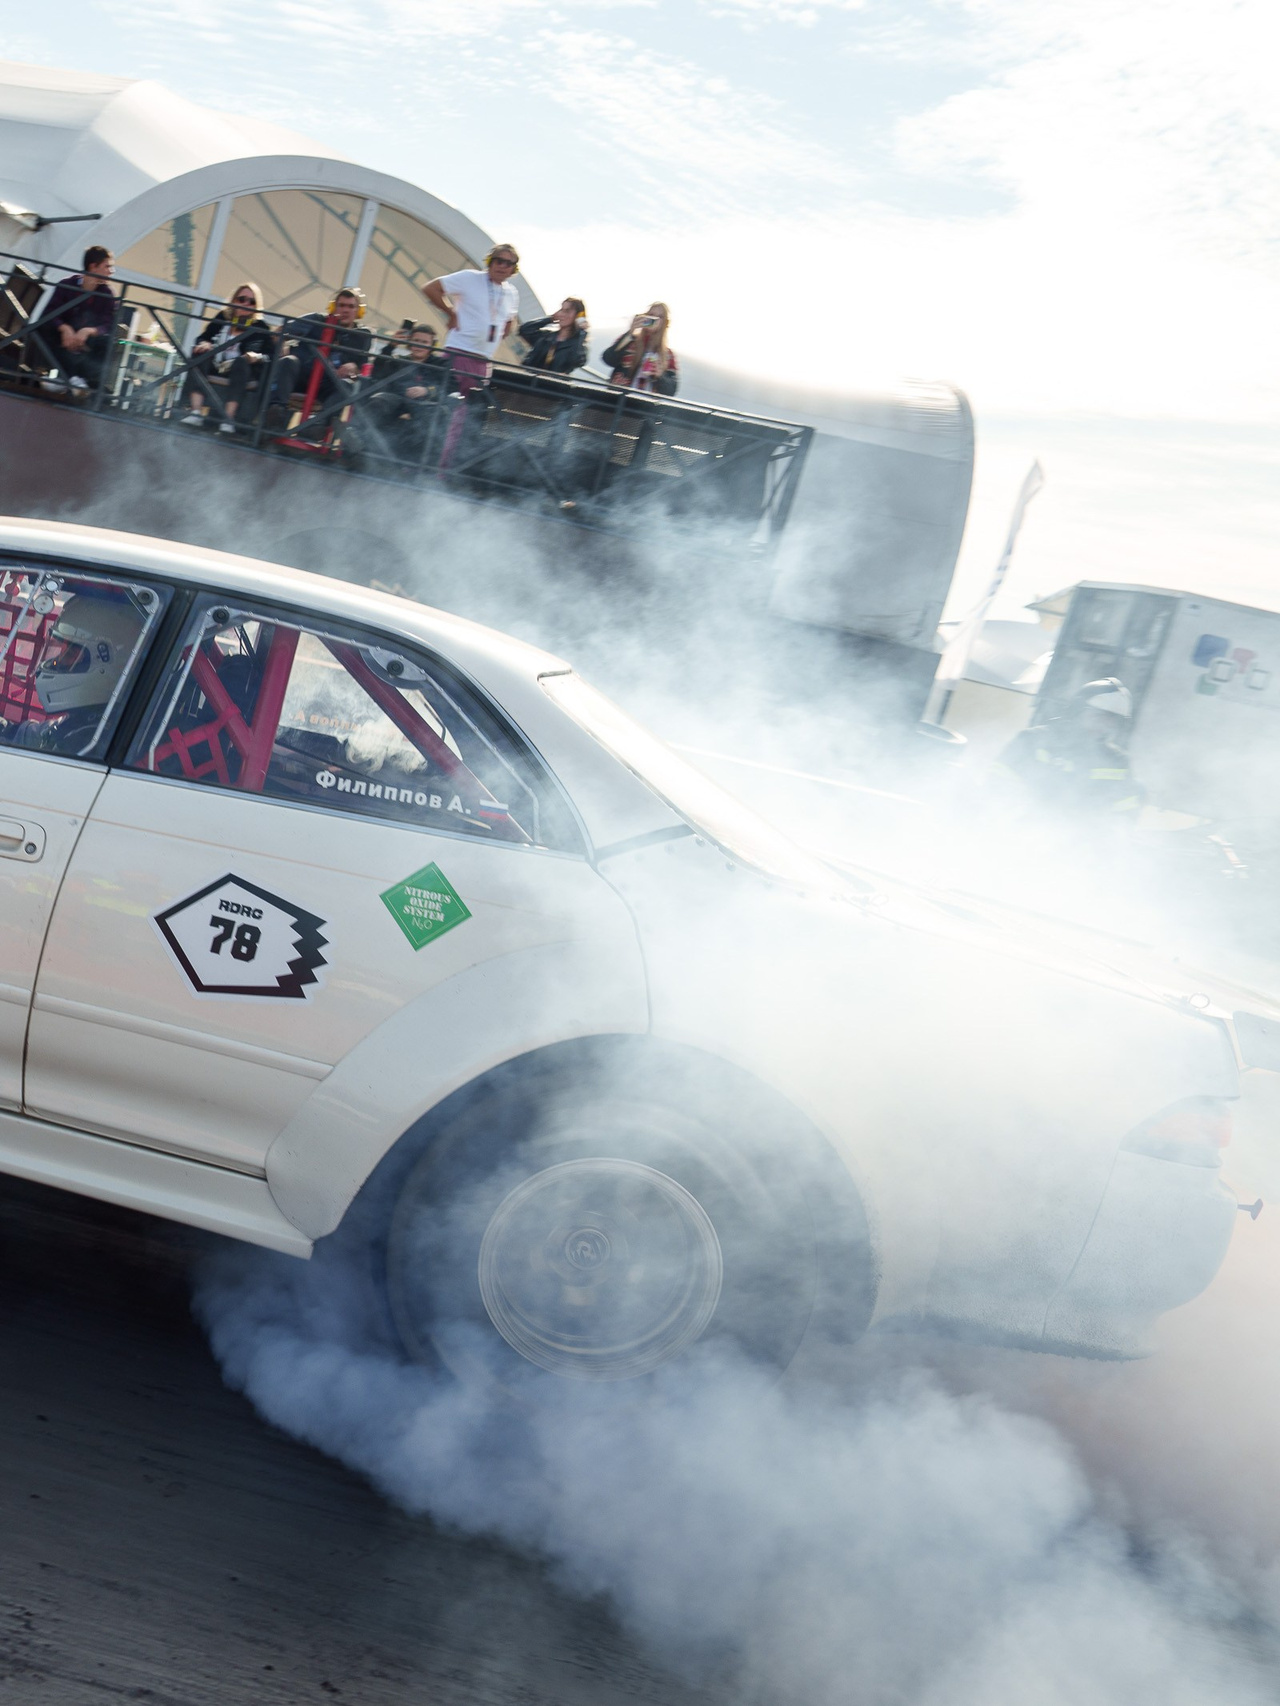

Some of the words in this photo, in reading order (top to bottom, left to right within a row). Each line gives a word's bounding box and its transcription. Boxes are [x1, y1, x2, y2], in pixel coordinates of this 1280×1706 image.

[315, 770, 443, 810] Филиппов
[447, 794, 472, 816] А.
[404, 885, 452, 905] NITROUS
[410, 896, 443, 912] OXIDE
[218, 898, 264, 921] RDRC
[402, 905, 445, 922] SYSTEM
[209, 914, 262, 964] 78
